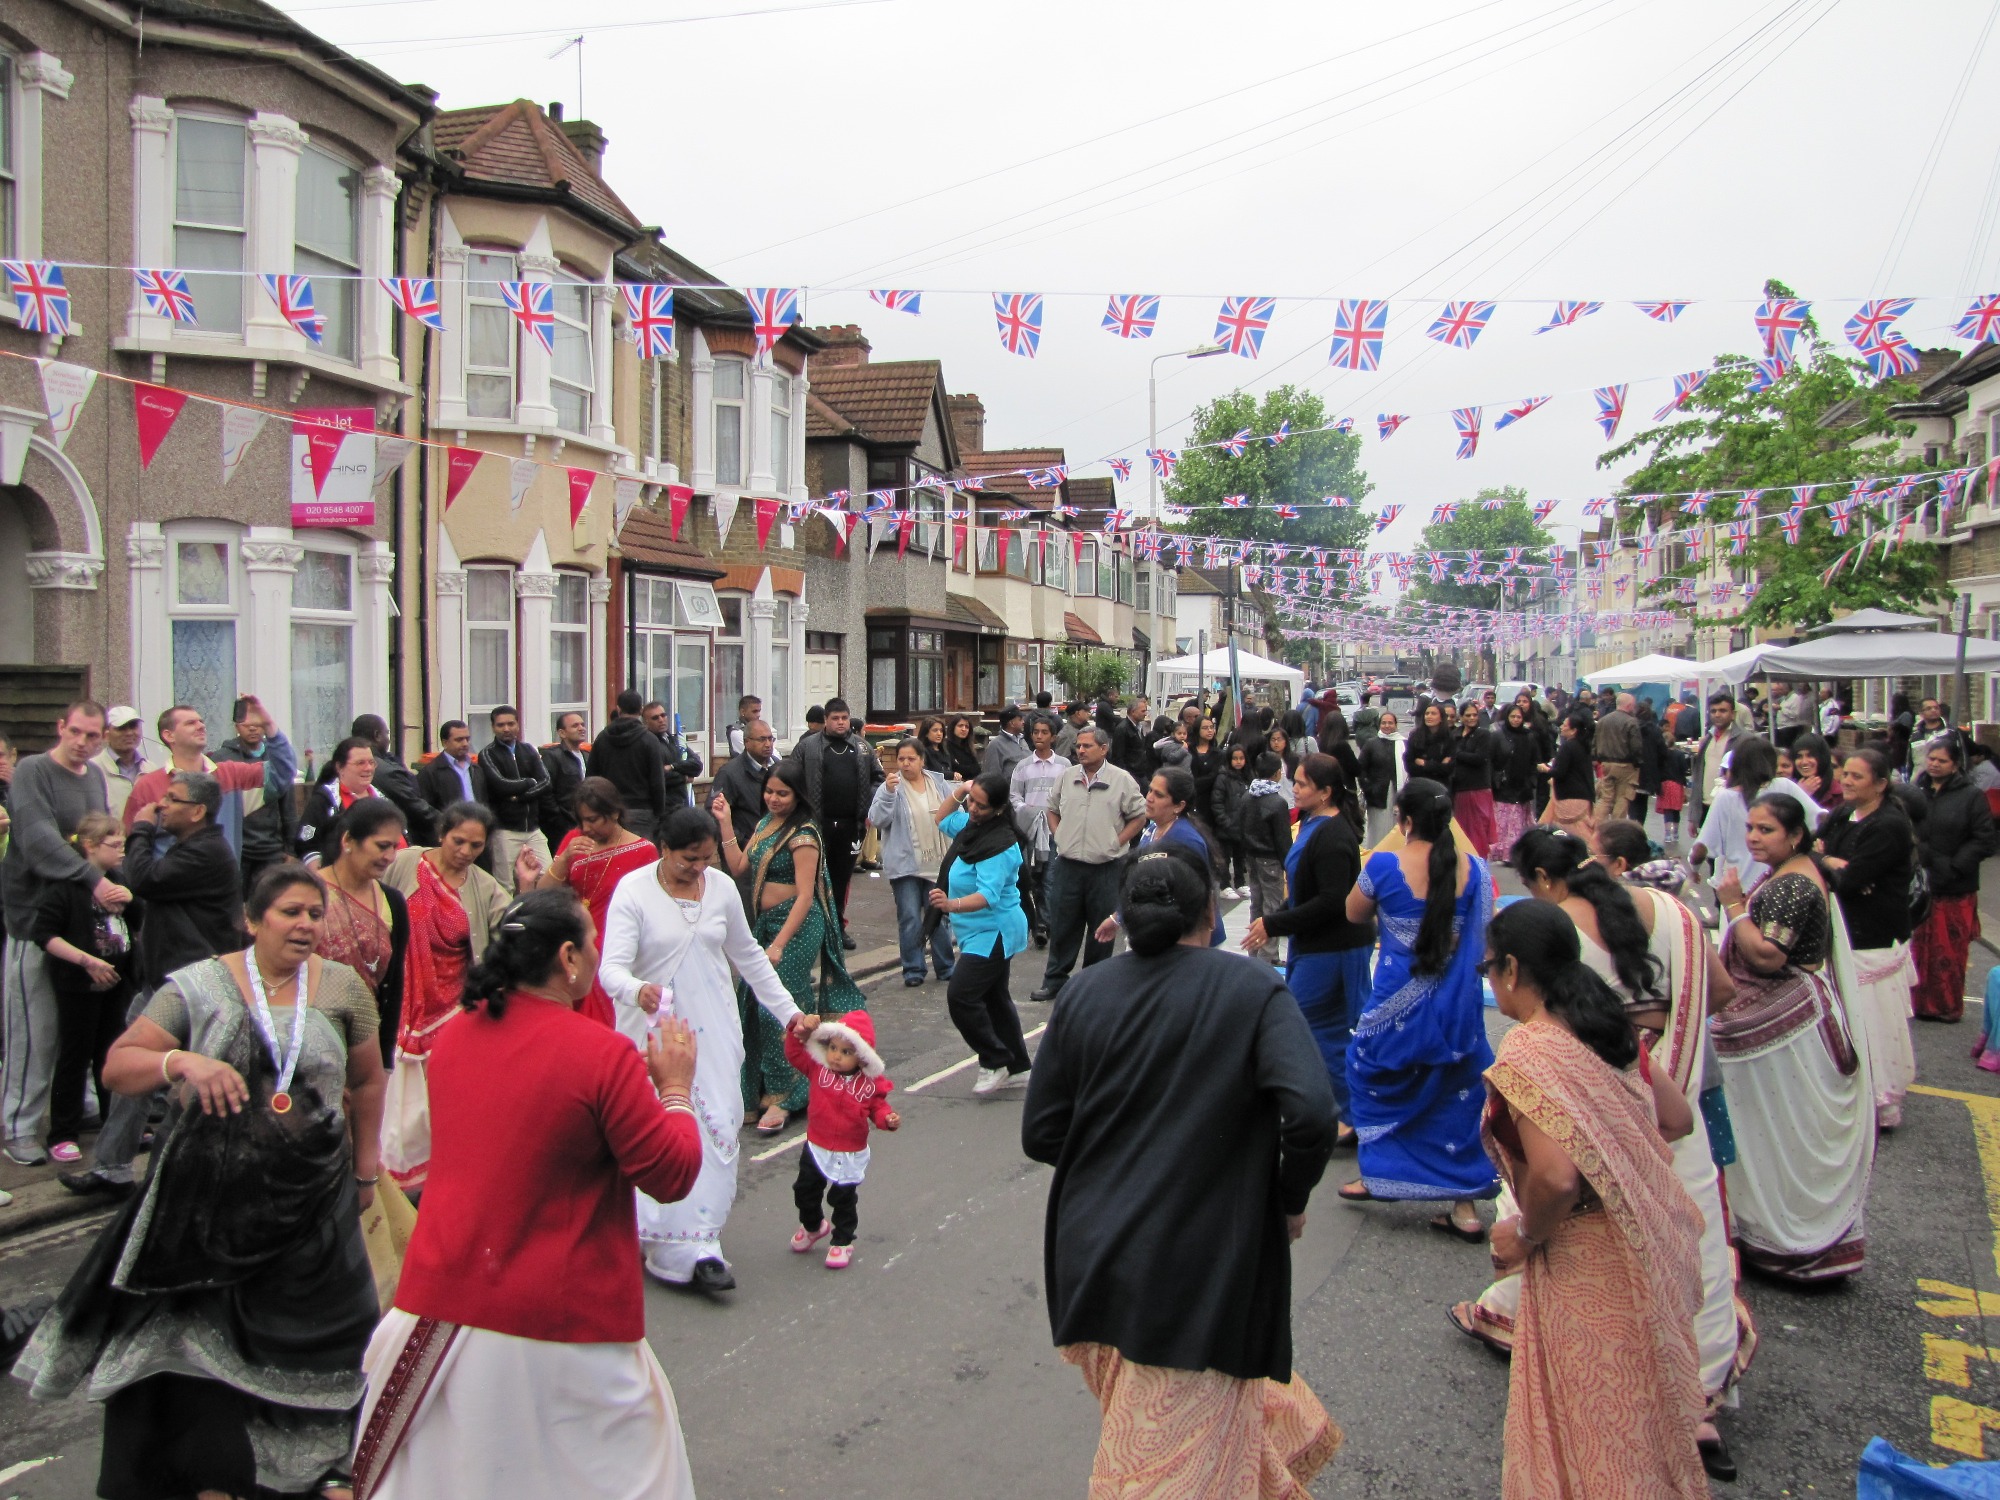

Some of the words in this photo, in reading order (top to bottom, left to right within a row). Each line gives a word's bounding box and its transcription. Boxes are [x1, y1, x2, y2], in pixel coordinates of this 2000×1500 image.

[53, 370, 81, 381] Newham
[66, 389, 83, 397] 2012
[317, 417, 331, 427] to
[336, 414, 352, 430] let
[306, 506, 322, 514] 020
[323, 506, 344, 514] 8548
[345, 505, 365, 514] 4007
